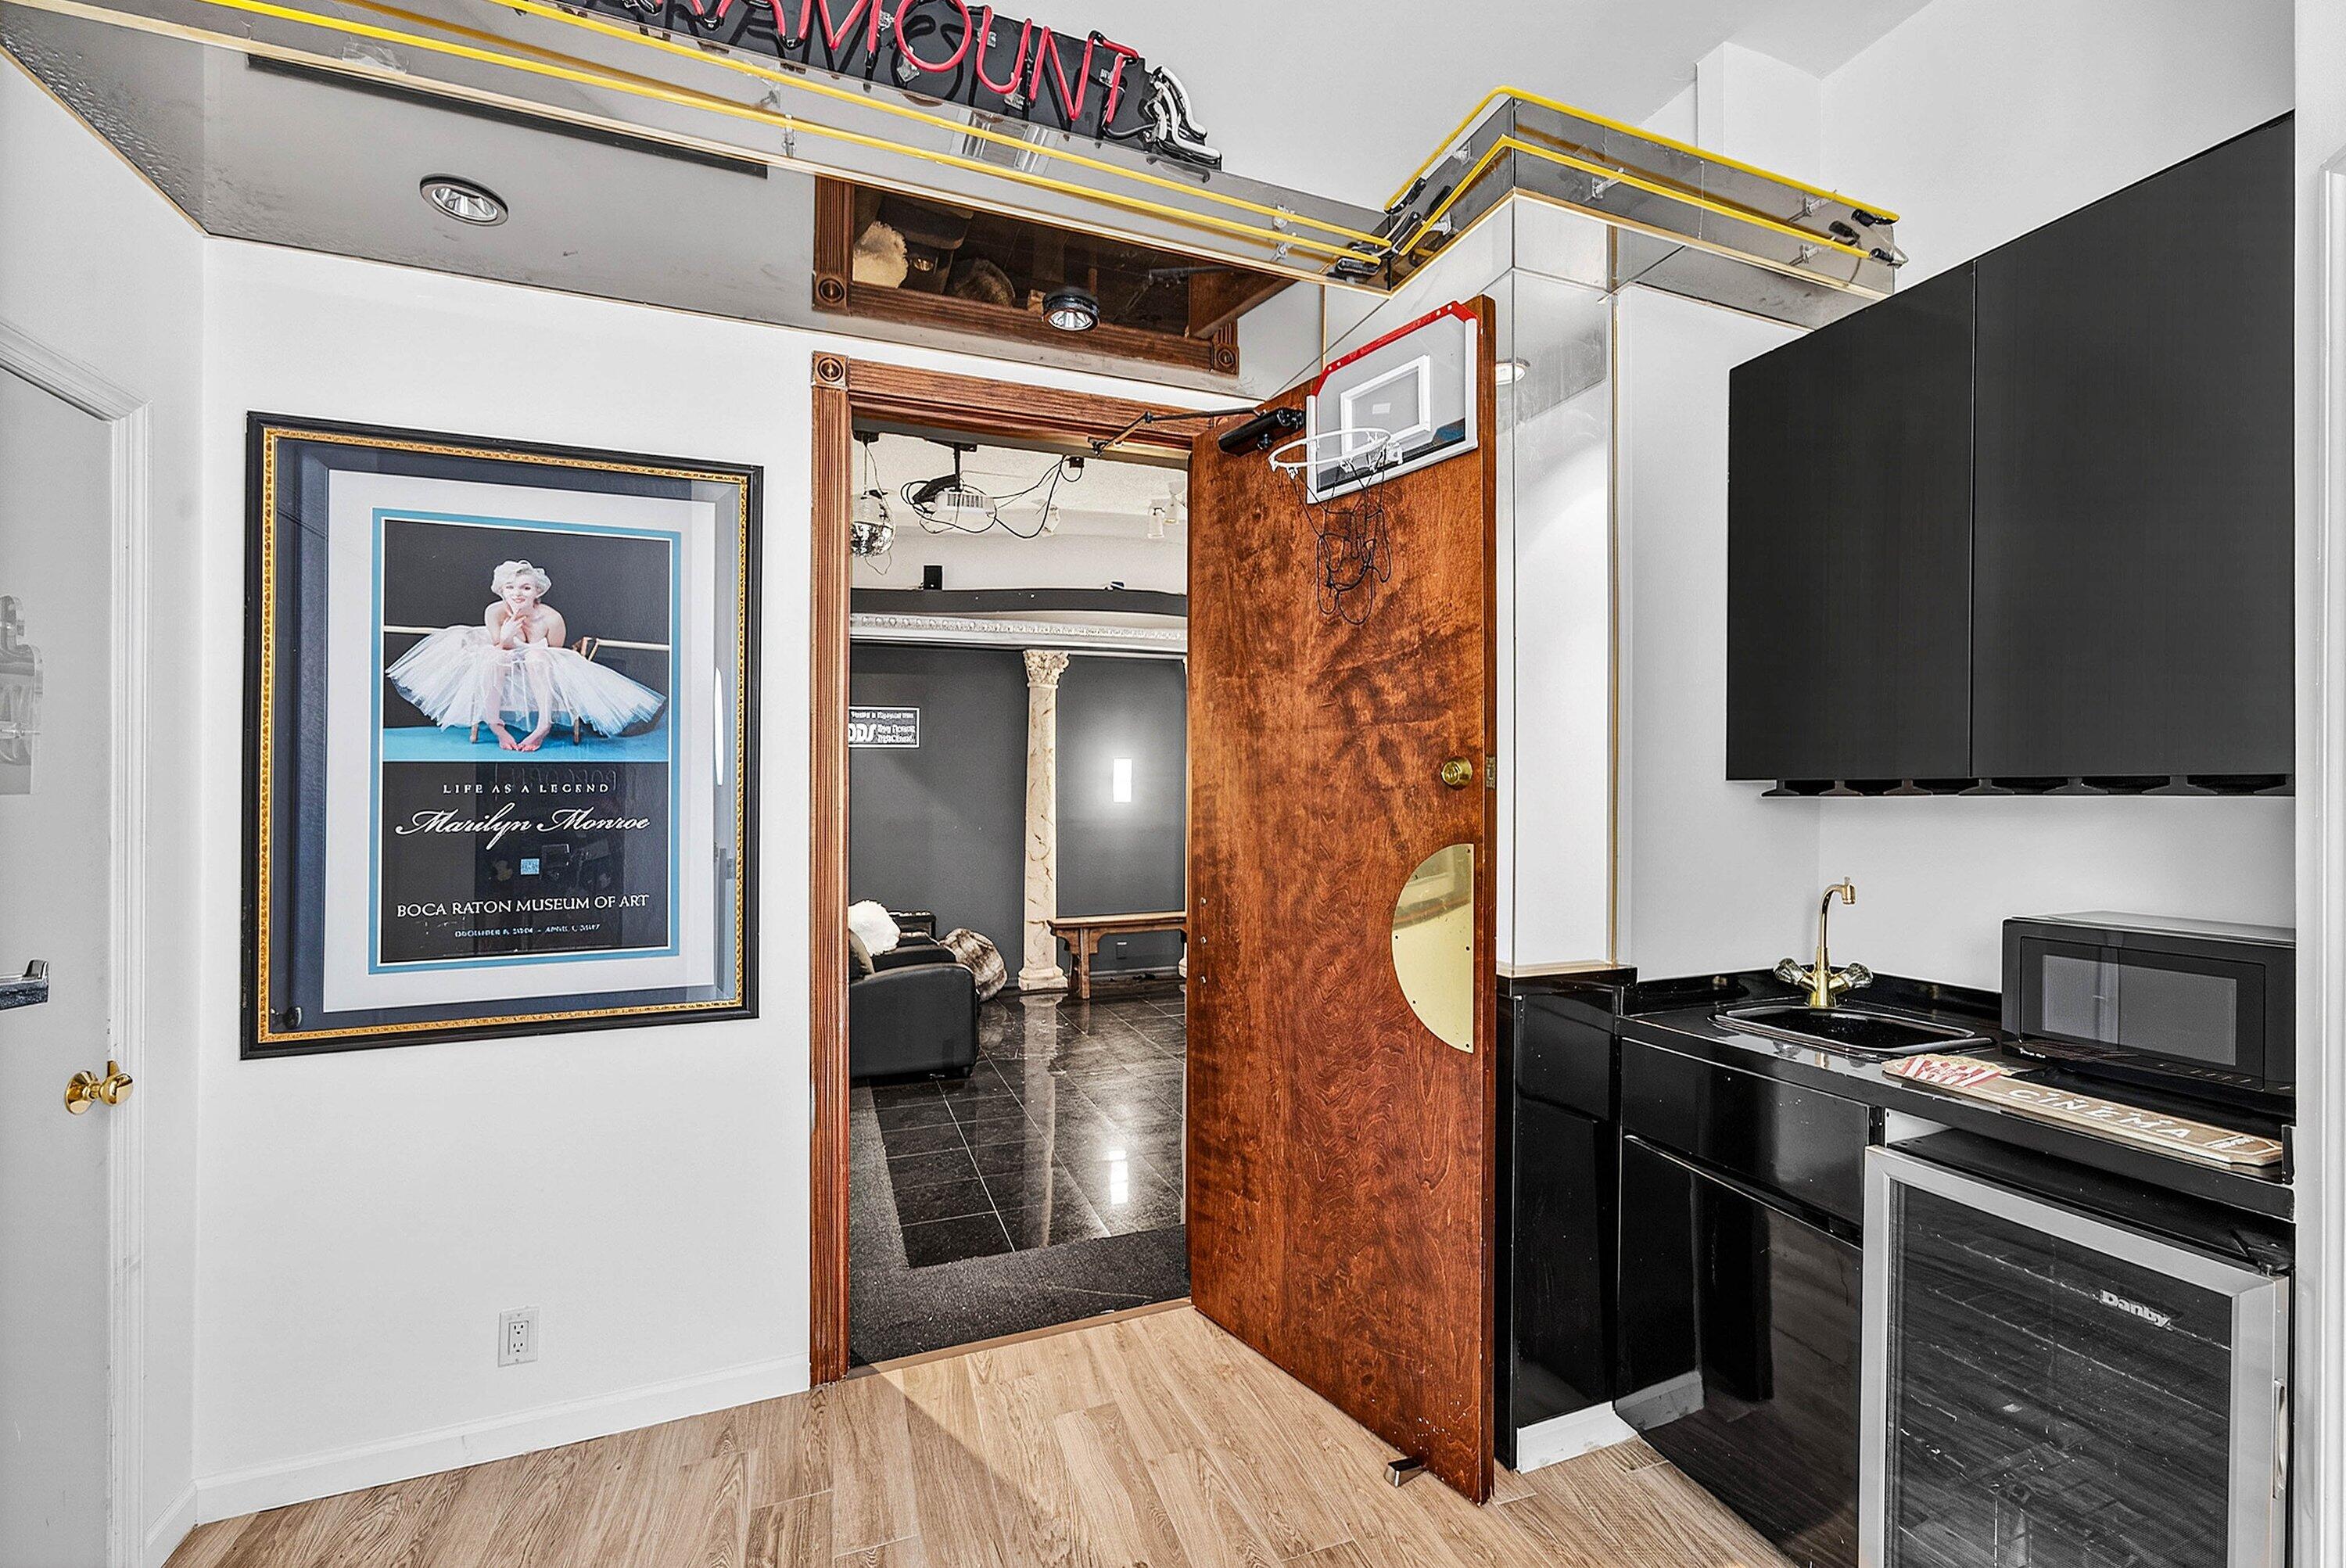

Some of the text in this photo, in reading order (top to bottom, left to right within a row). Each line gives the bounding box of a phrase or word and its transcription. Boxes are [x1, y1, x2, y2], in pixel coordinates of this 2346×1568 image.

[651, 0, 1141, 124] AMOUNT
[443, 783, 609, 794] LIFE AS A LEGEND
[395, 802, 651, 850] Marilyn Monroe
[396, 893, 650, 917] BOCA RATON MUSEUM OF ART
[2008, 1089, 2191, 1139] CINEMA
[2100, 1289, 2172, 1328] Danby
